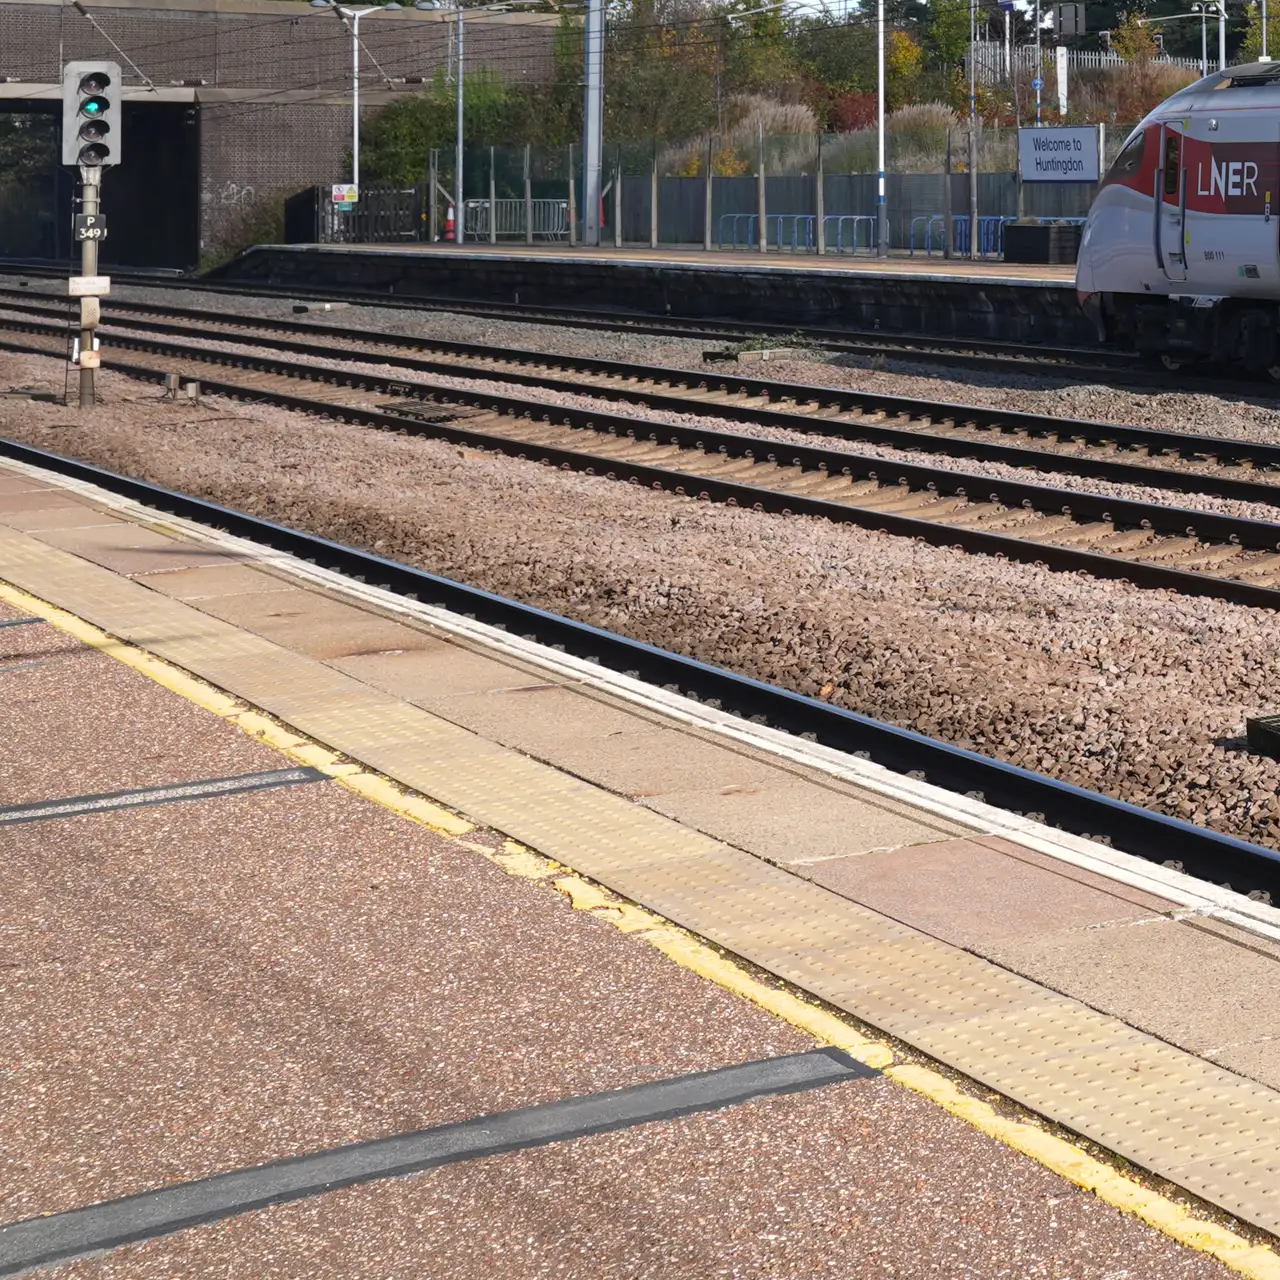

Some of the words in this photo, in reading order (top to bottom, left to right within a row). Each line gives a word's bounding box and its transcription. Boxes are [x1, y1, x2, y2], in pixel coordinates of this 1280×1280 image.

[1033, 137, 1071, 151] Welcome
[1073, 138, 1082, 151] to
[1035, 157, 1083, 174] Huntingdon
[1198, 154, 1258, 202] LNER
[87, 216, 95, 226] P
